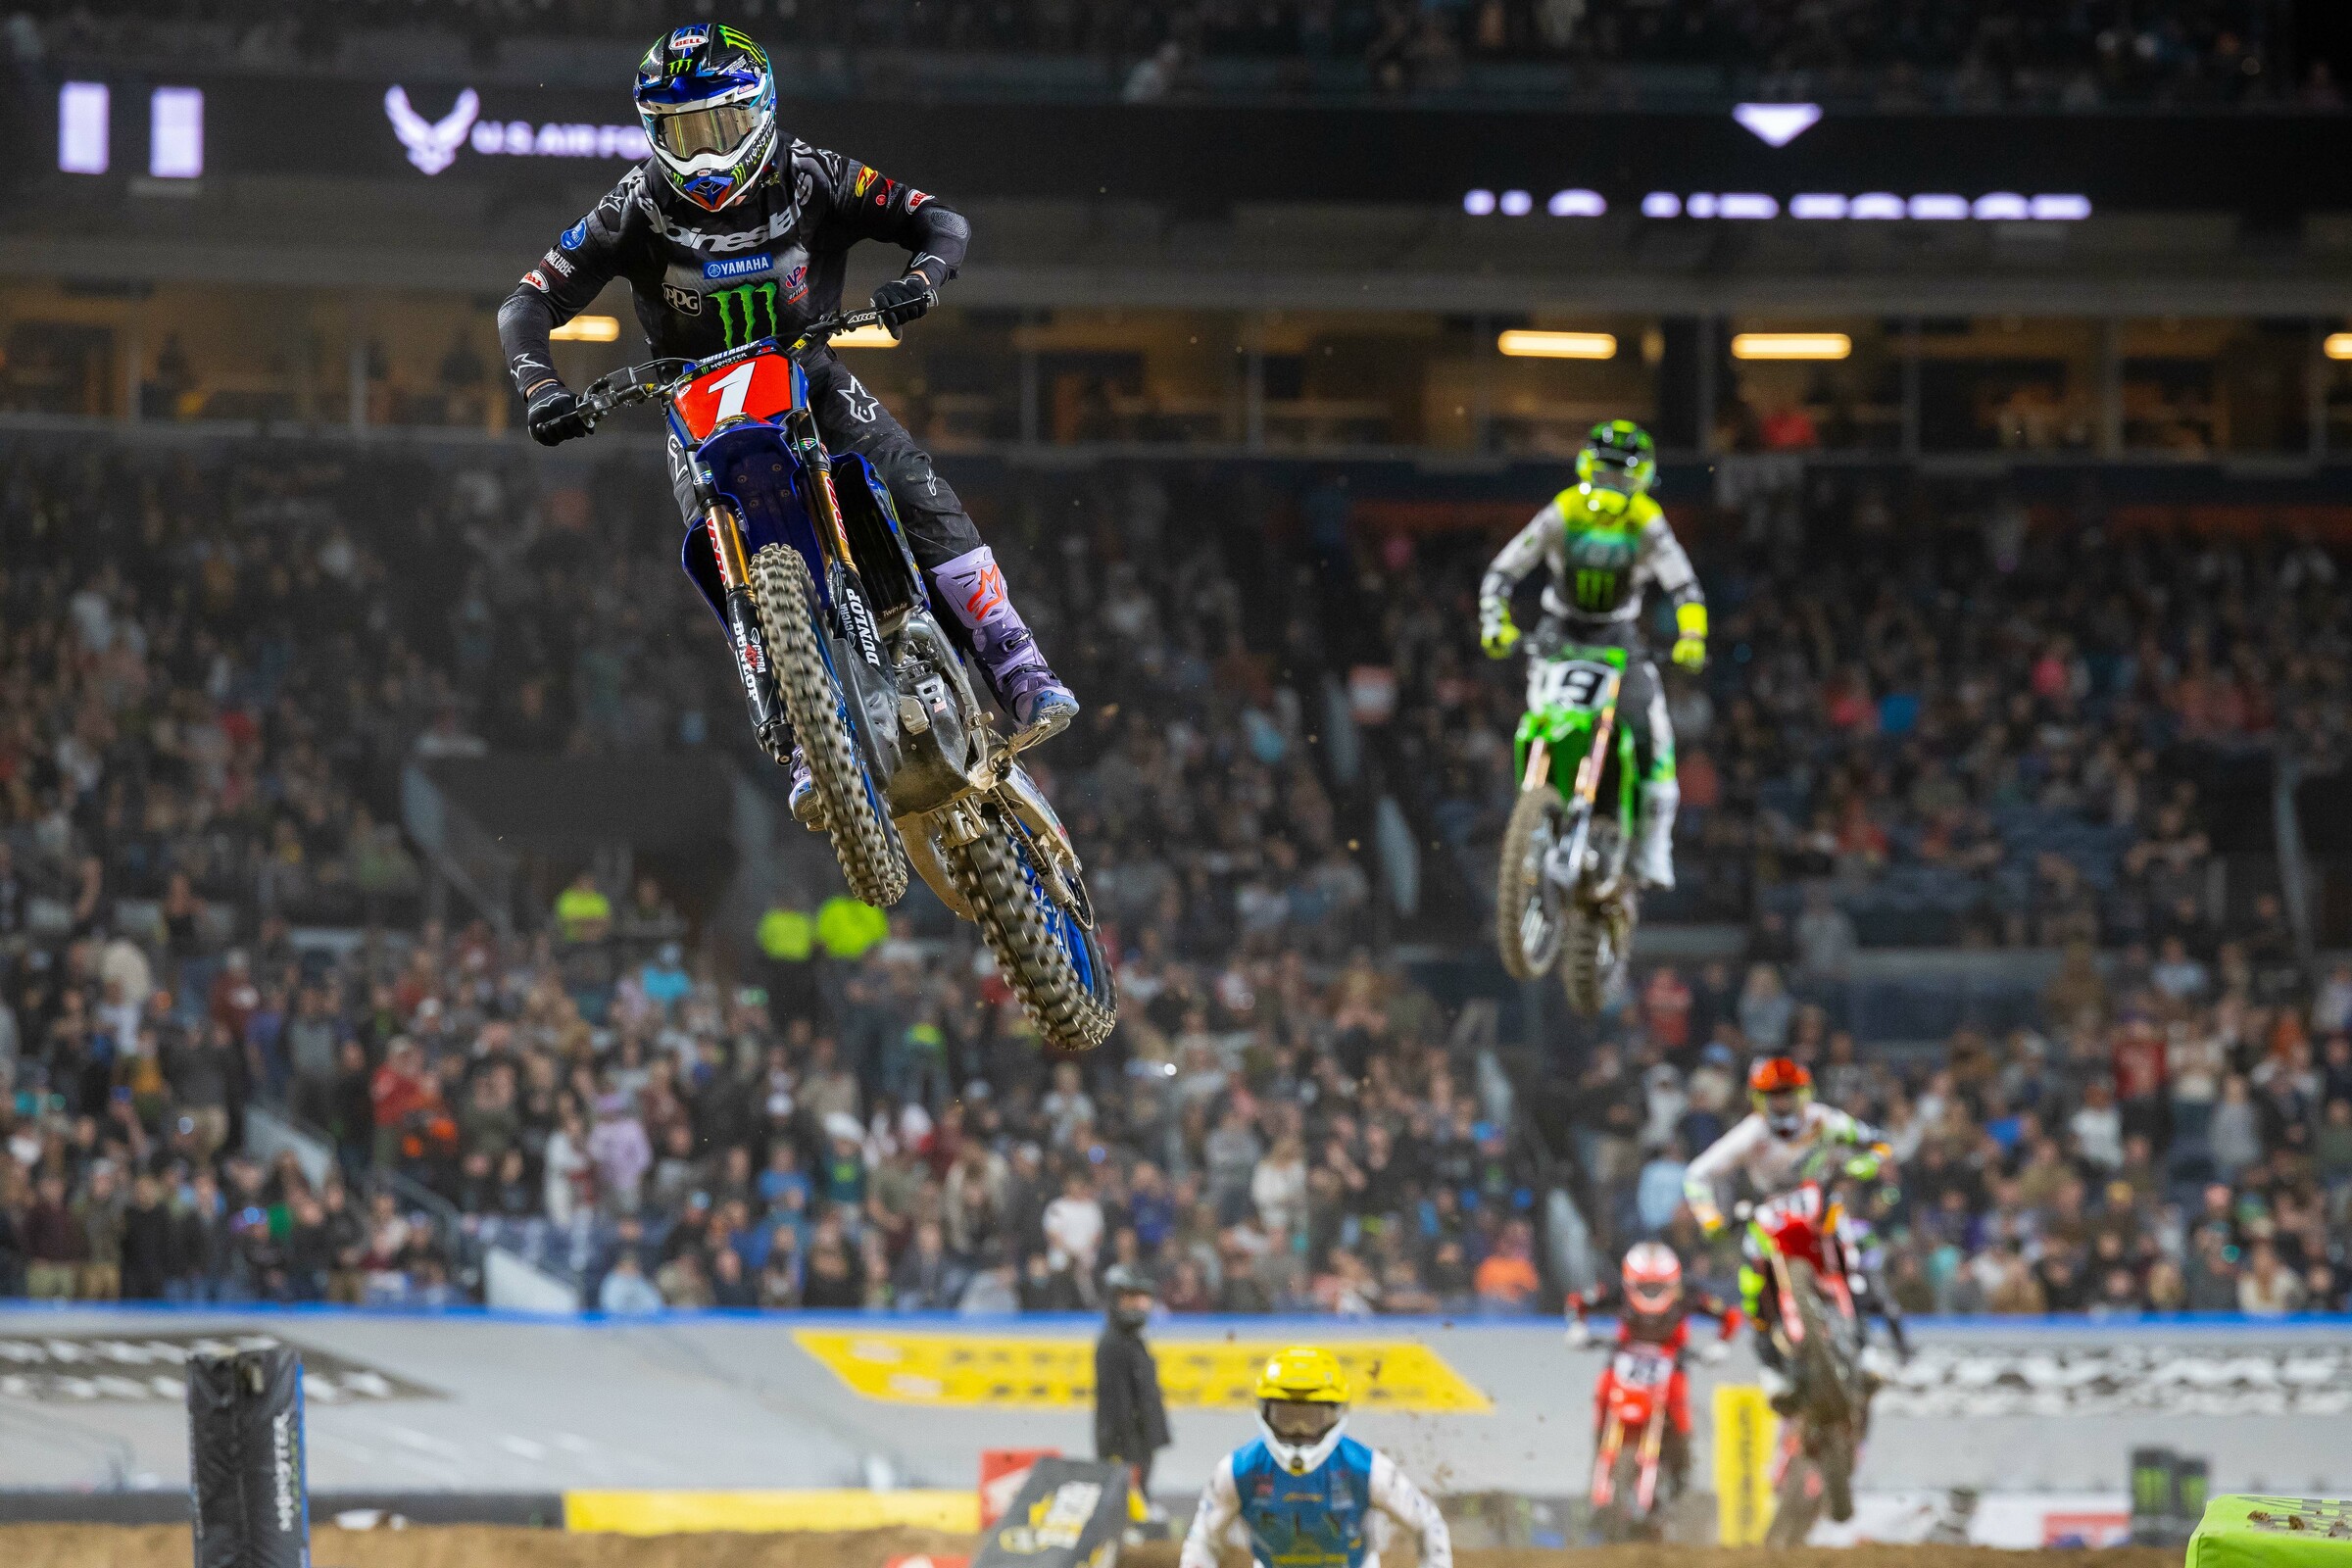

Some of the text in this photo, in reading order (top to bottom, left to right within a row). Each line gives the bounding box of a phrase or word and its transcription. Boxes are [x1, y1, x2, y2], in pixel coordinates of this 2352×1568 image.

[674, 37, 703, 47] BELL
[721, 256, 769, 275] YAMAHA
[786, 266, 802, 288] VP
[664, 288, 699, 311] PPG
[847, 312, 877, 324] ARC
[710, 352, 748, 369] MONSTER
[708, 361, 758, 423] 1
[840, 602, 855, 632] CYCRA
[882, 606, 899, 618] Twin
[846, 588, 881, 666] DUNLOP
[732, 619, 760, 702] DUNLOP
[756, 643, 766, 674] CYCRA
